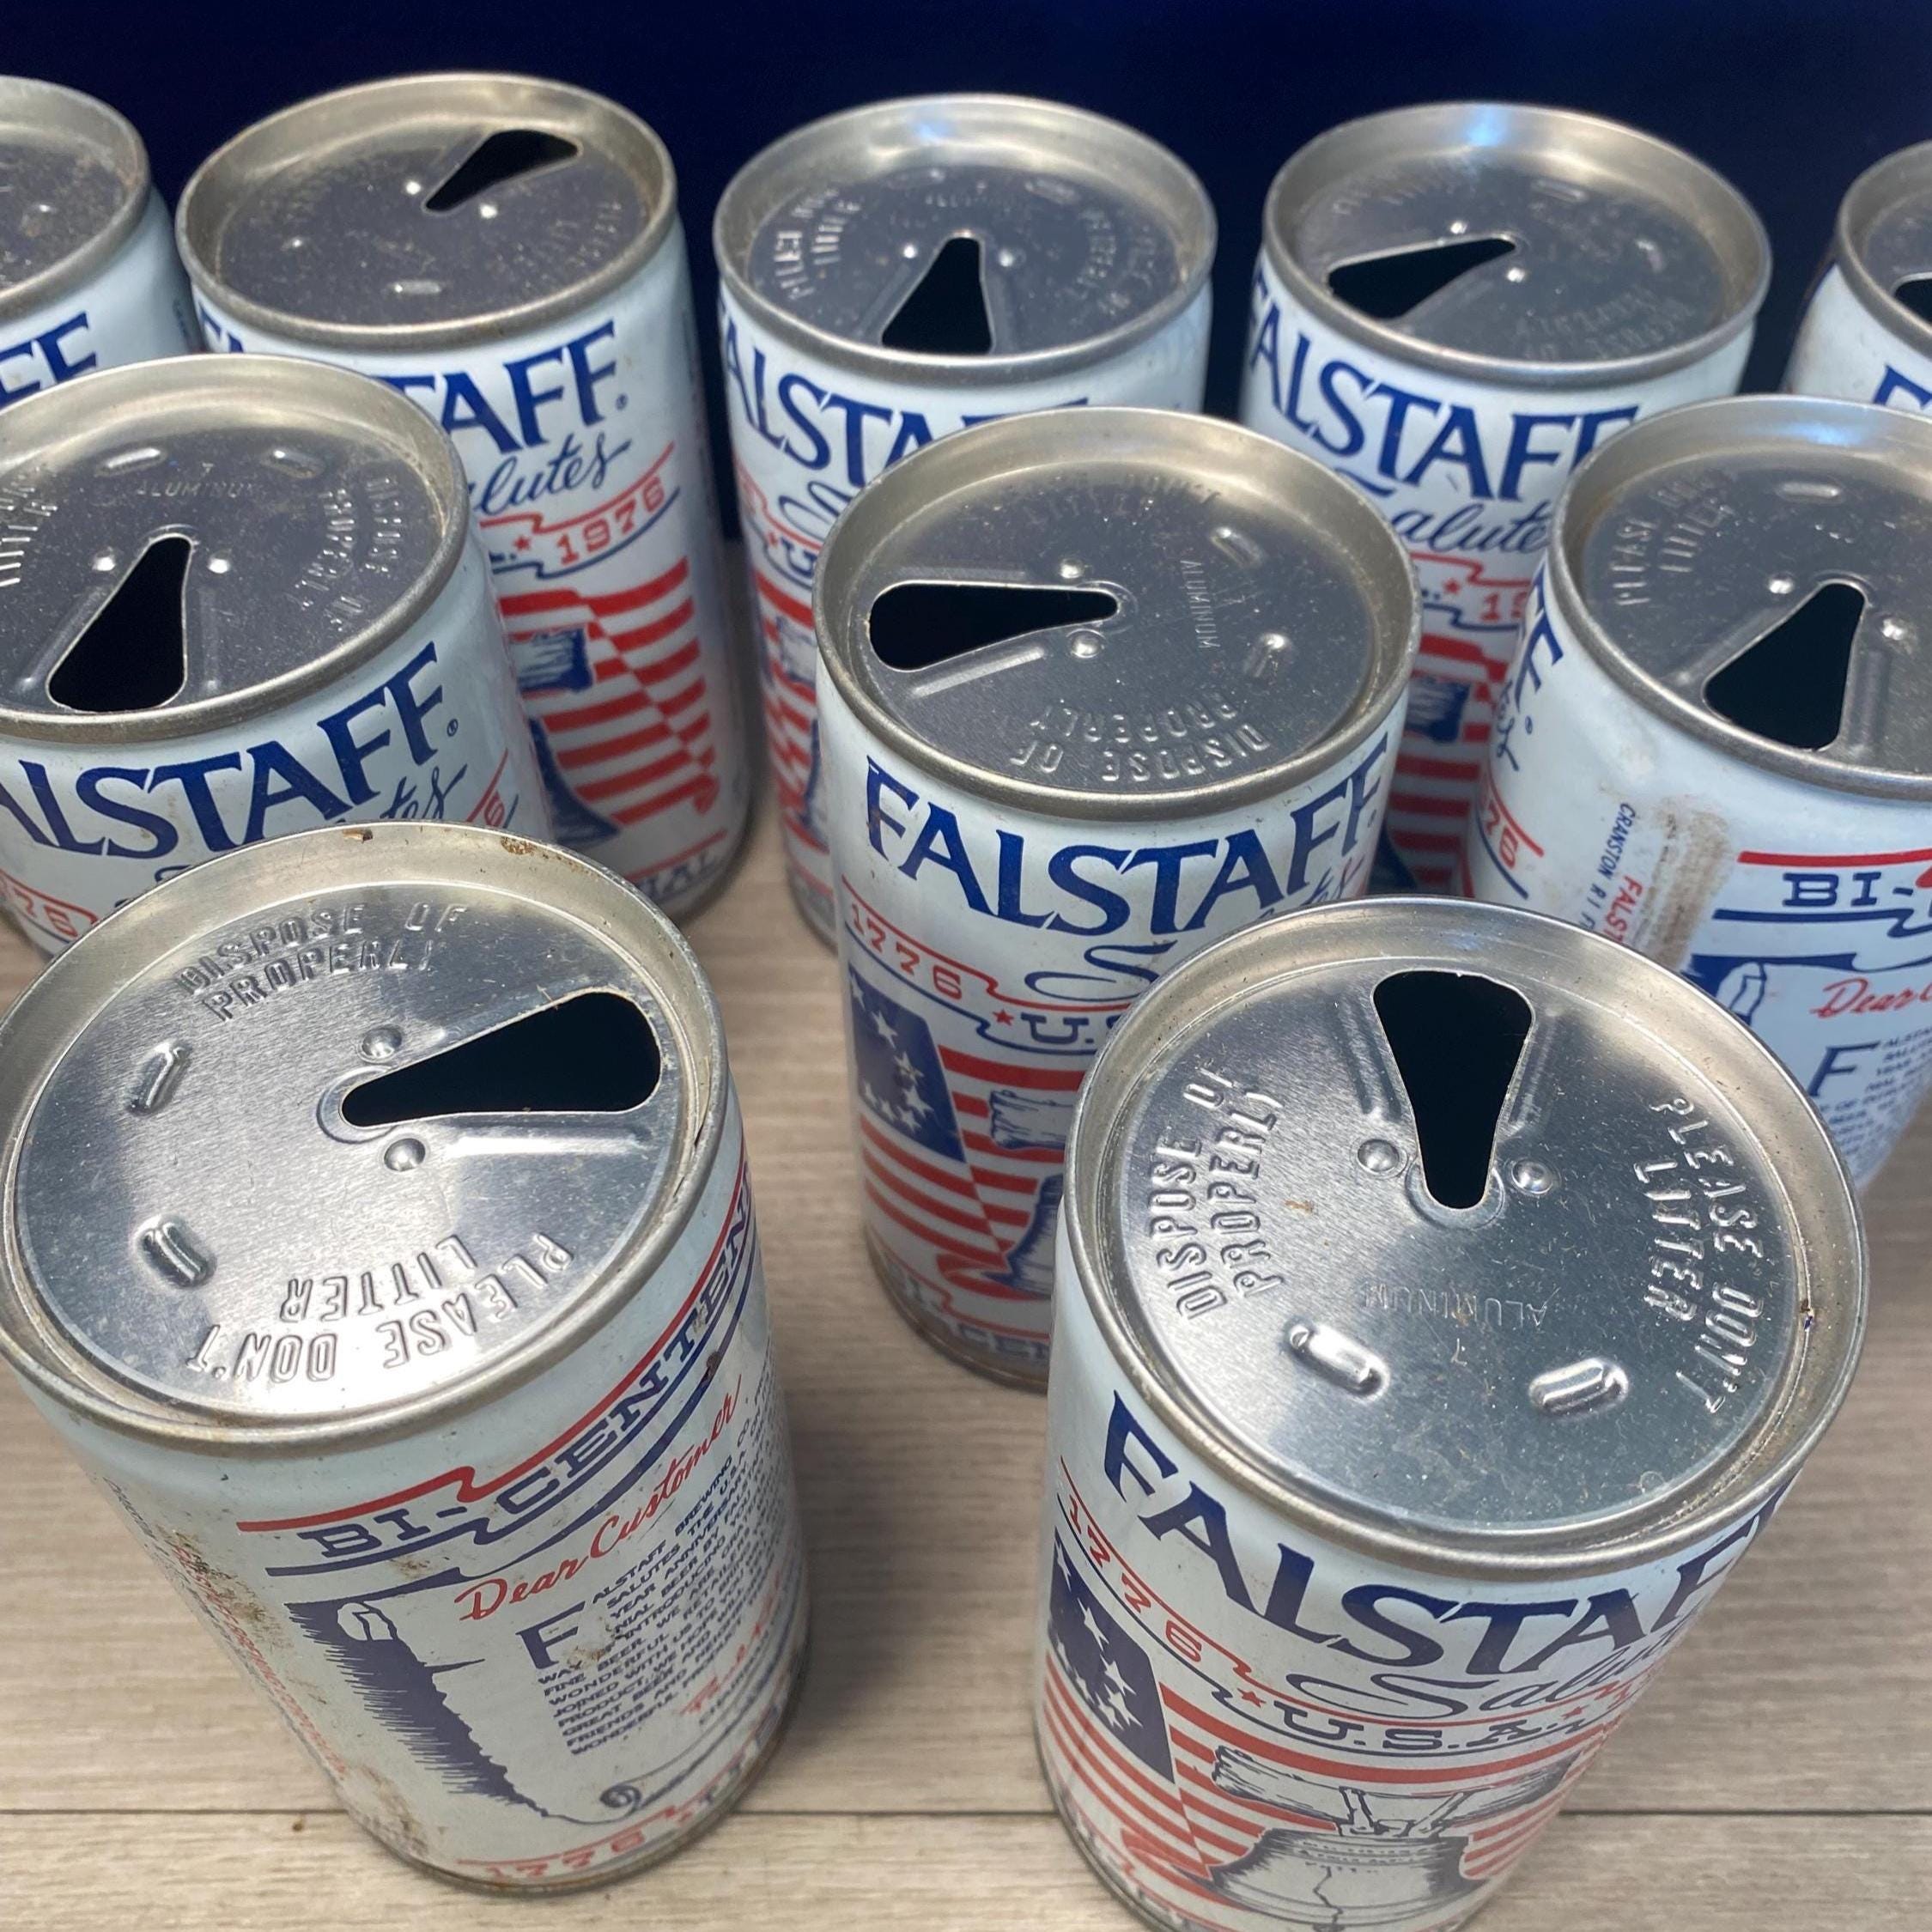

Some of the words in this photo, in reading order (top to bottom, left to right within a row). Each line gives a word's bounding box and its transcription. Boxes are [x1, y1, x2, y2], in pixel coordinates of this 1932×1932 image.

[557, 477, 665, 564] 1976
[1102, 724, 1271, 782] DISPOSE
[866, 736, 1389, 936] FALSTAFF
[1597, 801, 1637, 881] CRANSTON
[175, 904, 368, 995] DISPOSE
[404, 902, 468, 933] OF
[1649, 1097, 1764, 1259] PLEASE
[1148, 1135, 1230, 1321] DISPOSE
[1633, 1160, 1705, 1321] LITTER
[279, 1234, 479, 1323] LITTER
[376, 1232, 575, 1370] PLEASE
[295, 1161, 752, 1559] BI-CENTEN
[453, 1555, 591, 1623] Dear
[589, 1374, 744, 1559] Customer
[674, 1455, 732, 1536] BREWING
[608, 1543, 680, 1609] SALUTES
[688, 1501, 714, 1535] THE
[609, 1582, 656, 1618] YEAR
[660, 1555, 698, 1596] BEER
[702, 1526, 719, 1552] BY
[1068, 1492, 1203, 1664] 1776
[544, 1672, 586, 1698] FINE
[656, 1605, 679, 1627] WE
[548, 1632, 668, 1706] WONDERFUL
[623, 1644, 667, 1680] WITH
